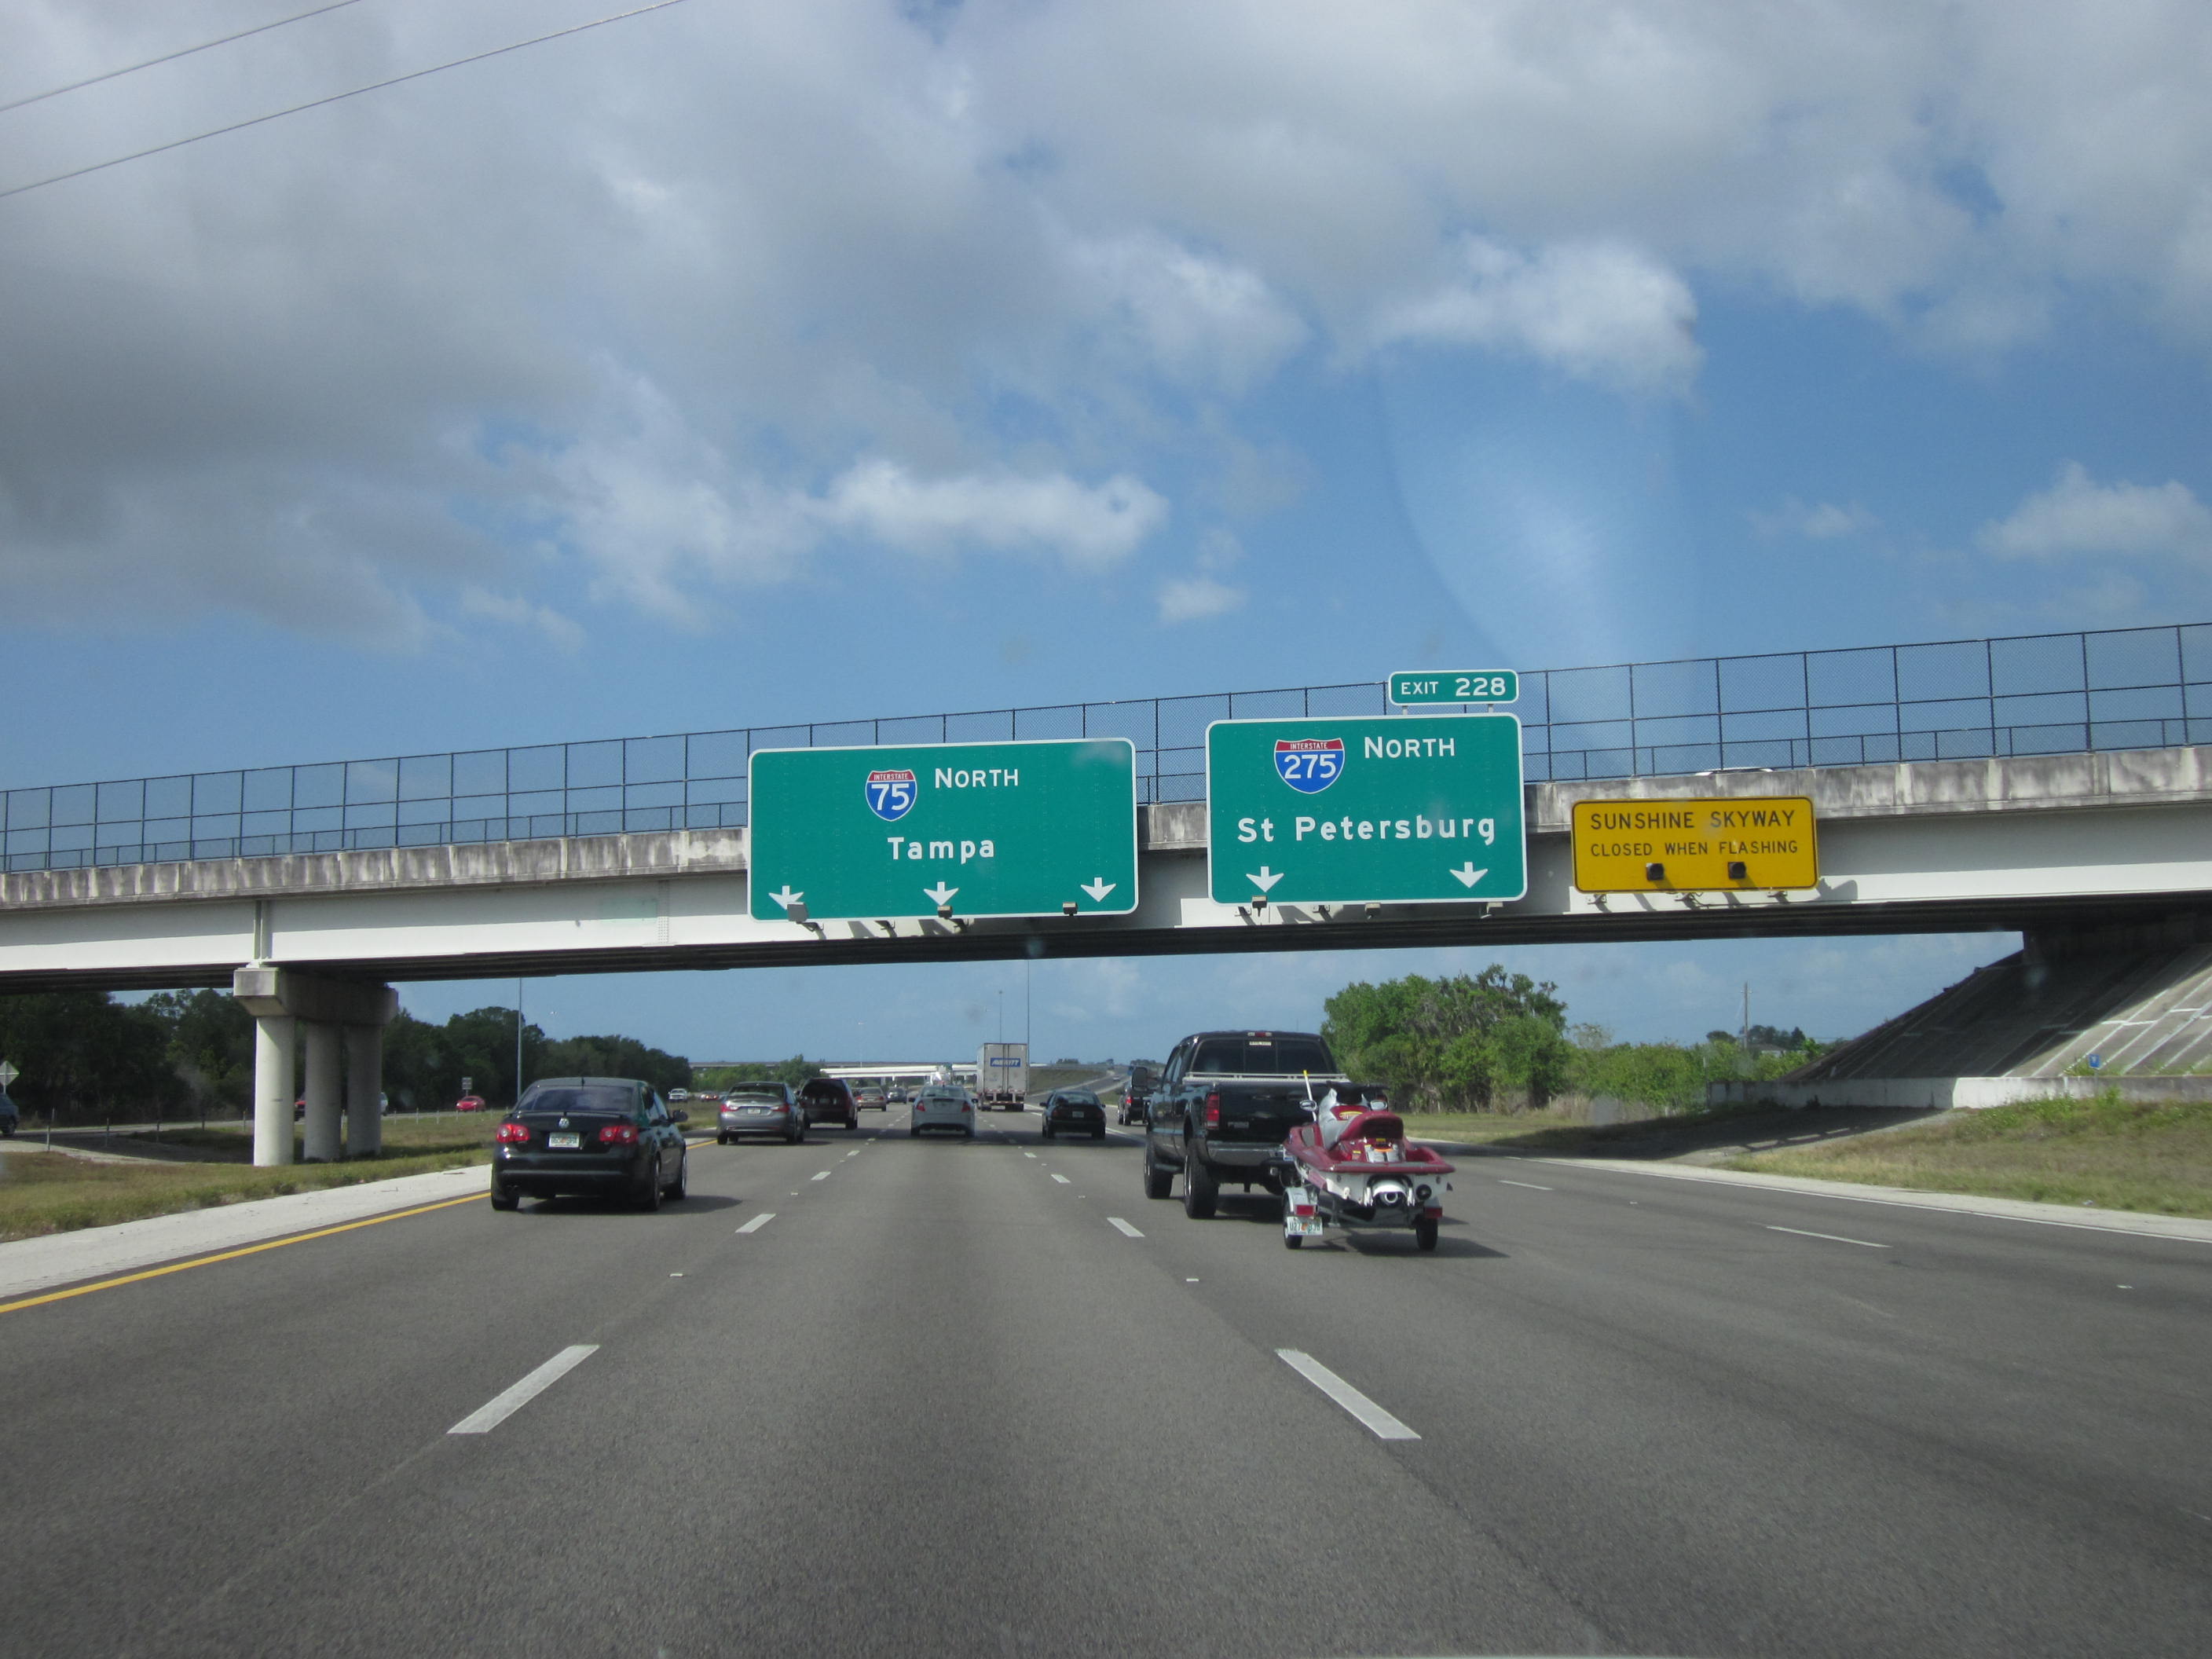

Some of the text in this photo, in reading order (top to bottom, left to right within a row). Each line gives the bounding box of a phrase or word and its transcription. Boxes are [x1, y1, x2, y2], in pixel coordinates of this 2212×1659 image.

[1401, 678, 1505, 696] EXIT 228
[1365, 737, 1454, 758] NORTH
[1284, 754, 1335, 778] 275
[936, 768, 1018, 788] NORTH
[871, 783, 909, 811] 75
[1238, 815, 1494, 845] St Petersburg
[1591, 811, 1794, 830] SUNSHINE SKYWAY
[888, 837, 994, 864] Tampa
[1591, 840, 1797, 856] CLOSED WHEN FLASHING
